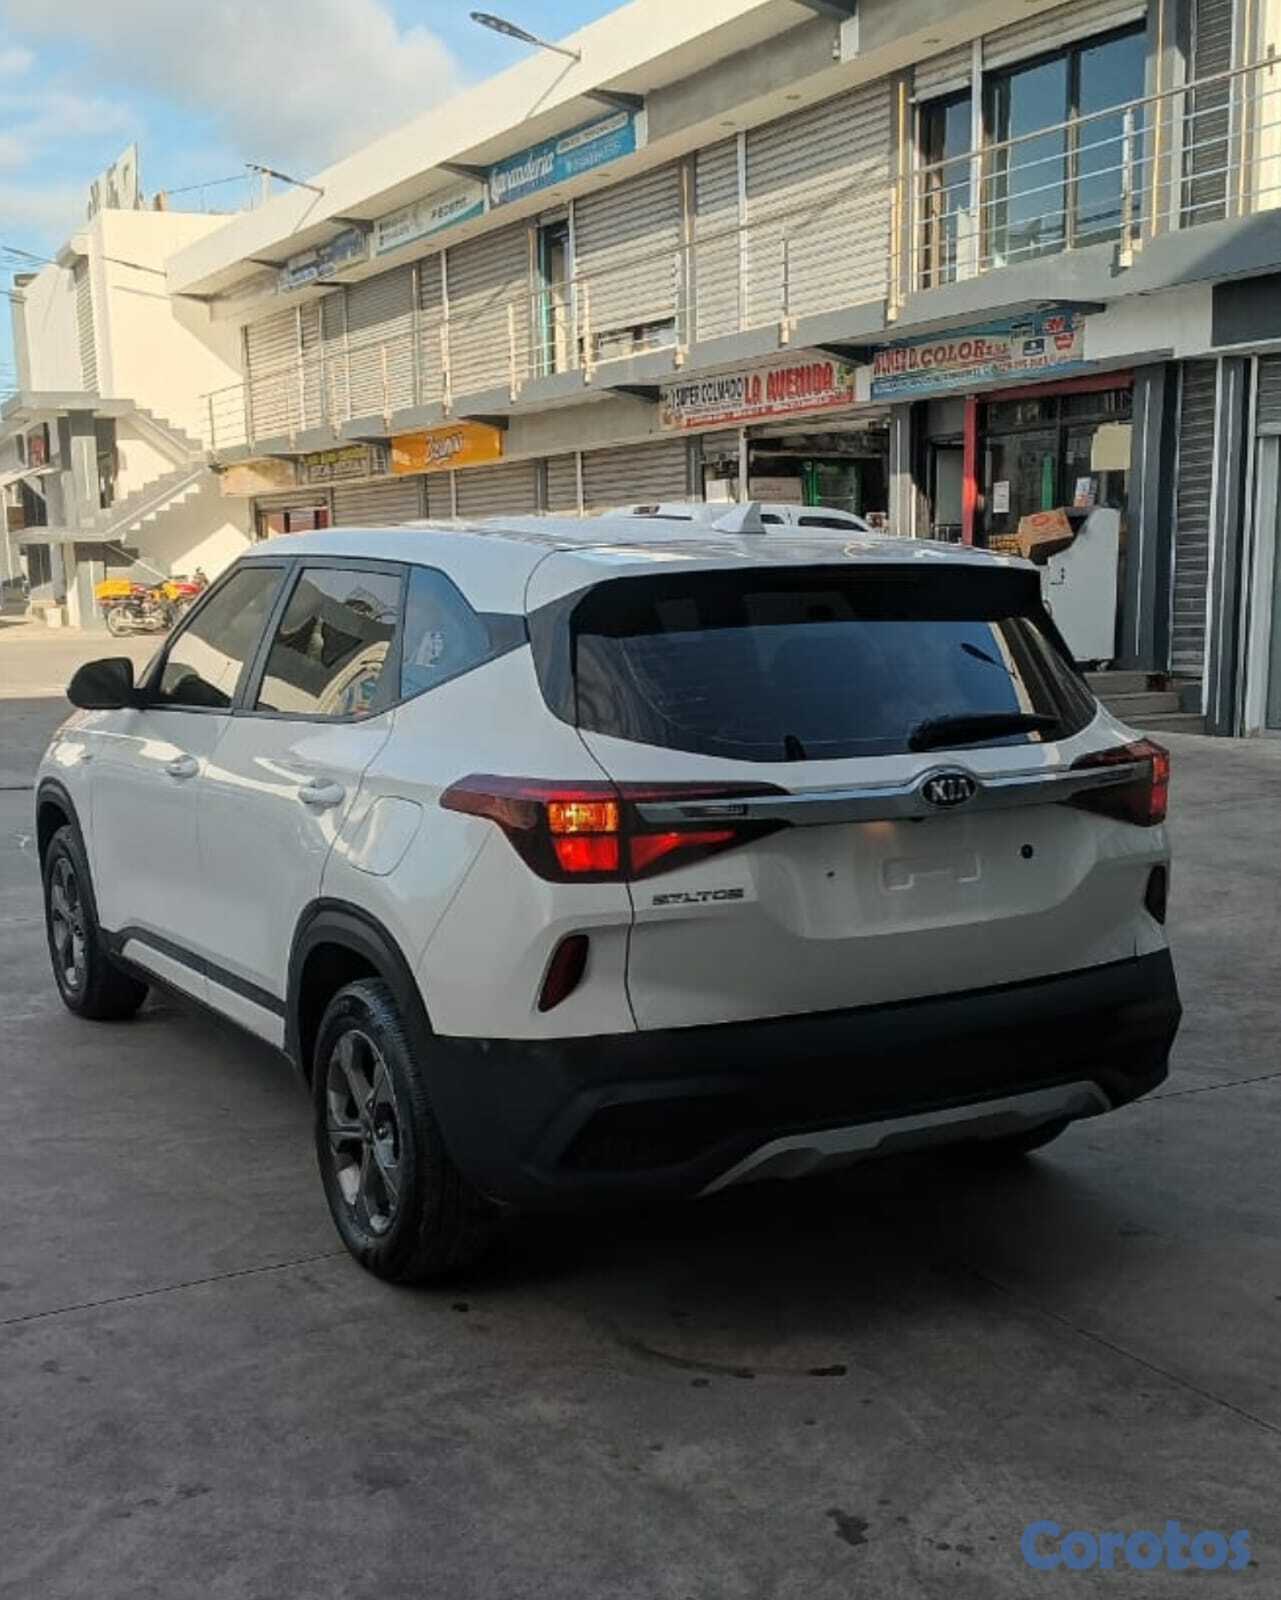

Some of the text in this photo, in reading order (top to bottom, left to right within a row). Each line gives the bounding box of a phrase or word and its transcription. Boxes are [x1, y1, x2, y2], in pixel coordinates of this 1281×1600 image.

[920, 339, 986, 367] COLOR
[675, 384, 700, 408] SUPER
[701, 376, 743, 403] COLMADO
[744, 374, 763, 405] LA
[766, 361, 834, 404] AVENIDA
[930, 778, 970, 801] KIA
[652, 888, 745, 906] SELTOS
